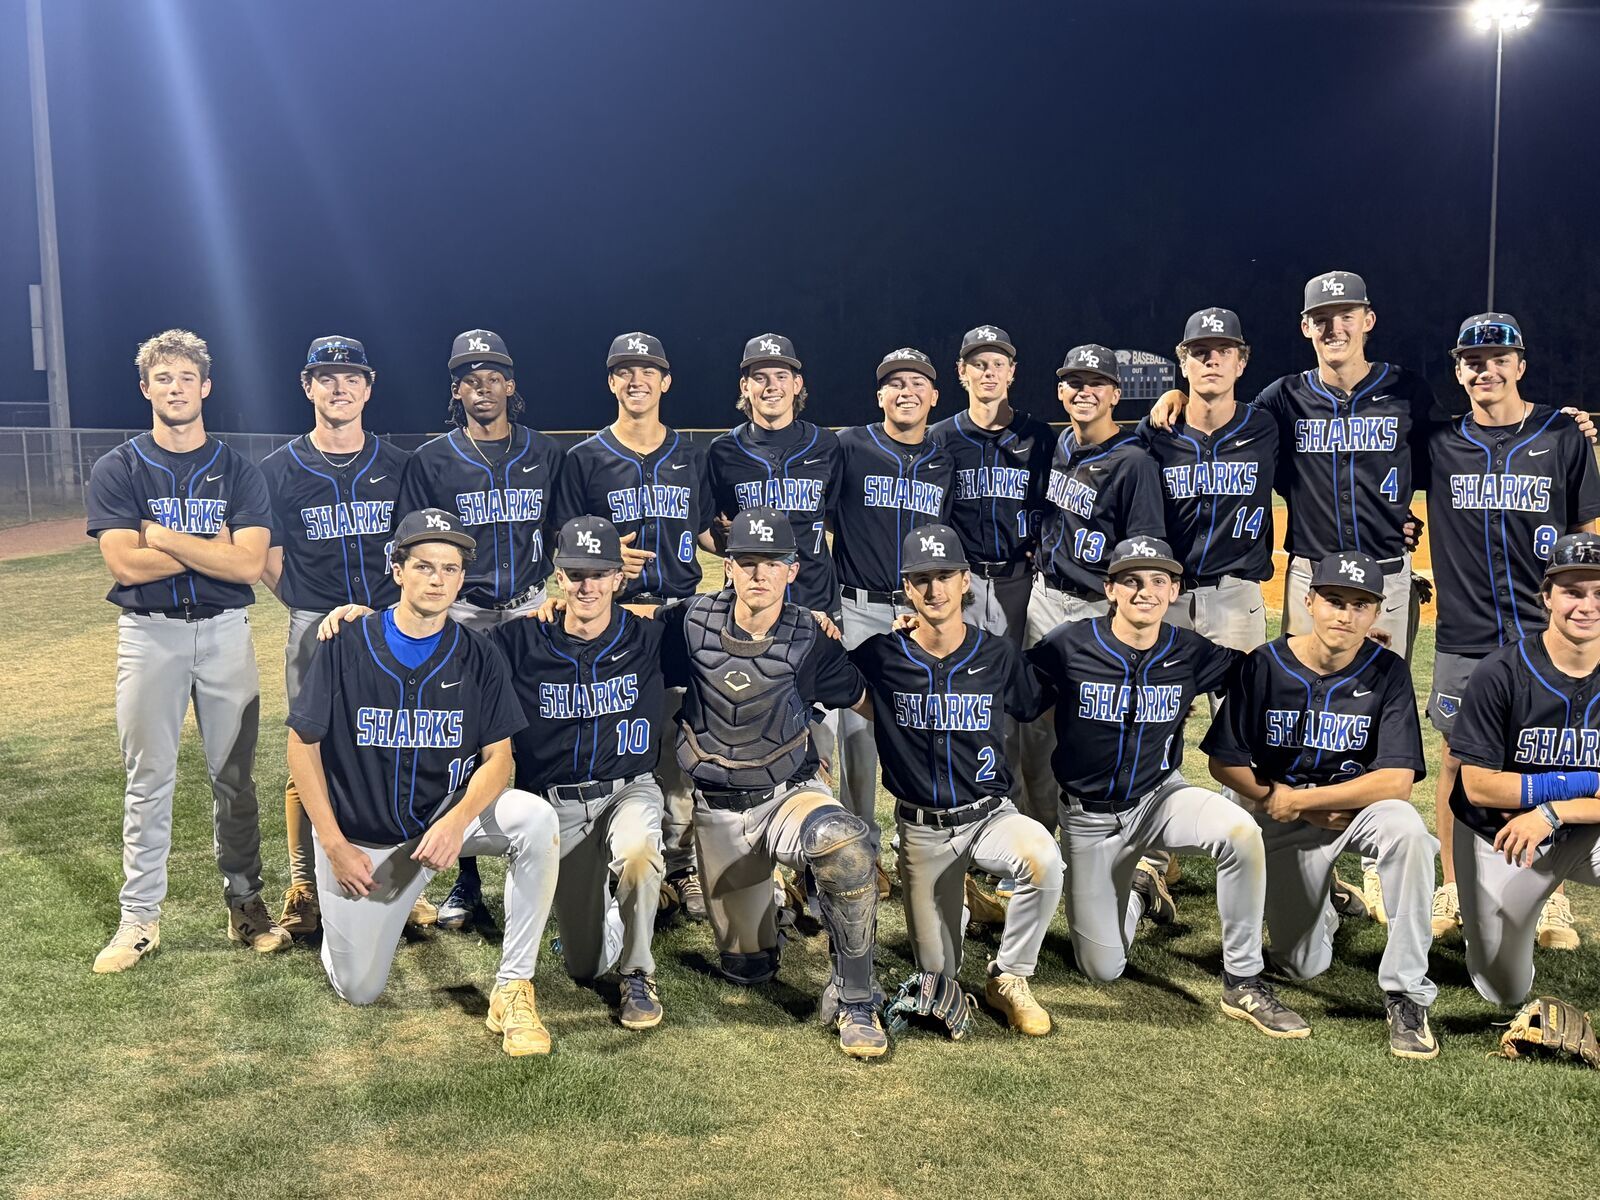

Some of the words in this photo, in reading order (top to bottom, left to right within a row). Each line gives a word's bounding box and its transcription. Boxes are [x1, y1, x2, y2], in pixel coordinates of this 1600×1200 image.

[1321, 277, 1345, 296] MR
[977, 328, 997, 341] MR
[1201, 315, 1224, 333] MR
[627, 338, 649, 354] MR
[759, 339, 781, 356] MR
[1078, 350, 1100, 368] MR
[1132, 350, 1167, 365] BASEBALL
[1294, 416, 1398, 453] SHARKS
[734, 477, 823, 511] SHARKS
[864, 475, 943, 517] SHARKS
[1162, 461, 1259, 500] SHARKS
[1380, 467, 1398, 502] 4
[1450, 473, 1552, 513] SHARKS
[301, 501, 394, 541] SHARKS
[455, 488, 543, 526] SHARKS
[607, 485, 691, 523] SHARKS
[749, 519, 774, 542] MR
[812, 521, 824, 554] 7
[1232, 506, 1265, 540] 14
[576, 531, 601, 554] MR
[677, 530, 693, 563] 6
[920, 535, 945, 557] MR
[1074, 528, 1107, 564] 13
[1533, 524, 1558, 561] 8
[1339, 559, 1365, 584] MR
[538, 673, 639, 720] SHARKS
[893, 691, 993, 732] SHARKS
[1078, 681, 1182, 723] SHARKS
[356, 707, 464, 748] SHARKS
[616, 718, 650, 756] 10
[1265, 709, 1372, 752] SHARKS
[975, 745, 997, 783] 2
[1514, 727, 1600, 767] SHAR
